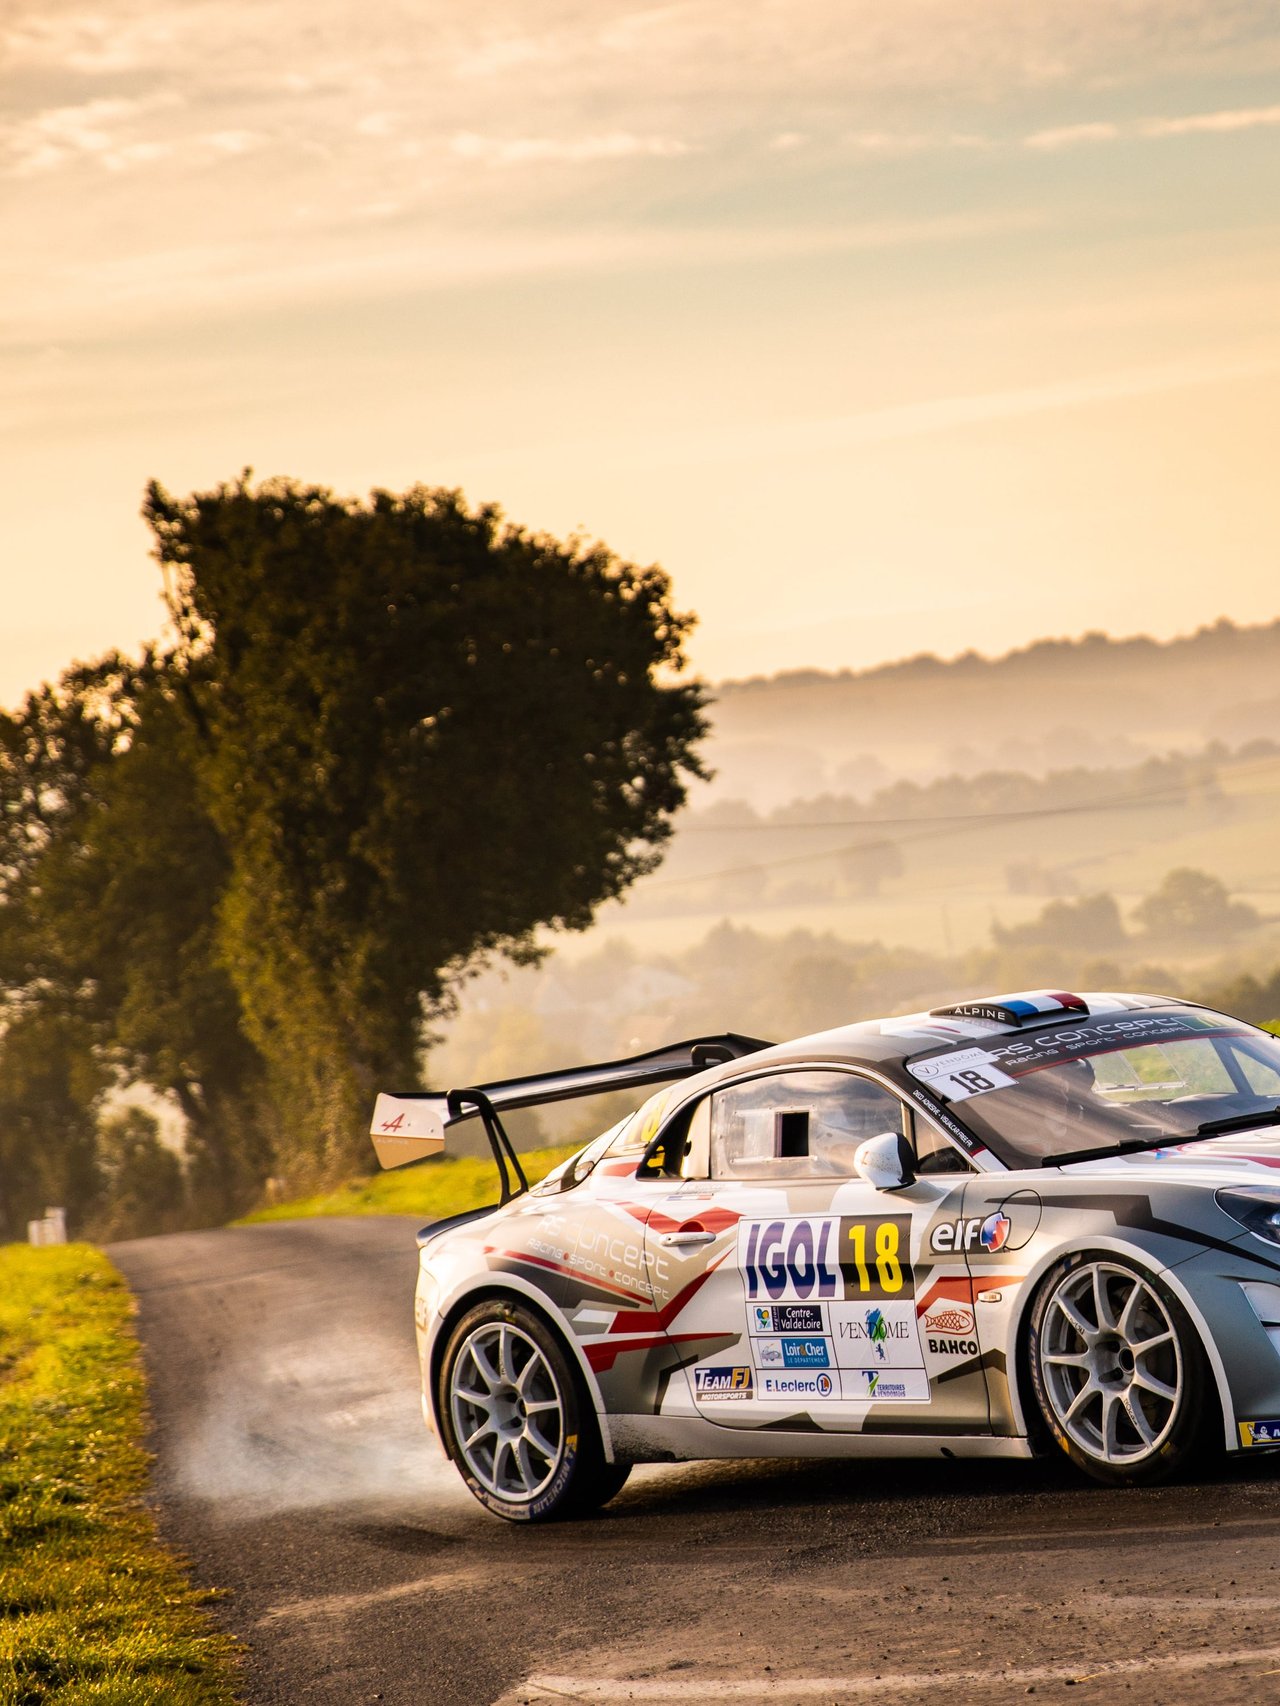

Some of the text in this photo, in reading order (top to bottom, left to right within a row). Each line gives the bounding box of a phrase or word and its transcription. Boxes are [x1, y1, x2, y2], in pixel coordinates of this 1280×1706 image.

[954, 1006, 1006, 1021] ALPINE
[949, 1069, 996, 1095] 18
[930, 1218, 981, 1251] elf
[745, 1220, 903, 1300] IGOL 18
[785, 1307, 814, 1319] Centre-
[928, 1339, 978, 1355] BAHCO
[766, 1379, 816, 1393] E.Leclerc
[701, 1392, 748, 1401] MOTORSPORTS
